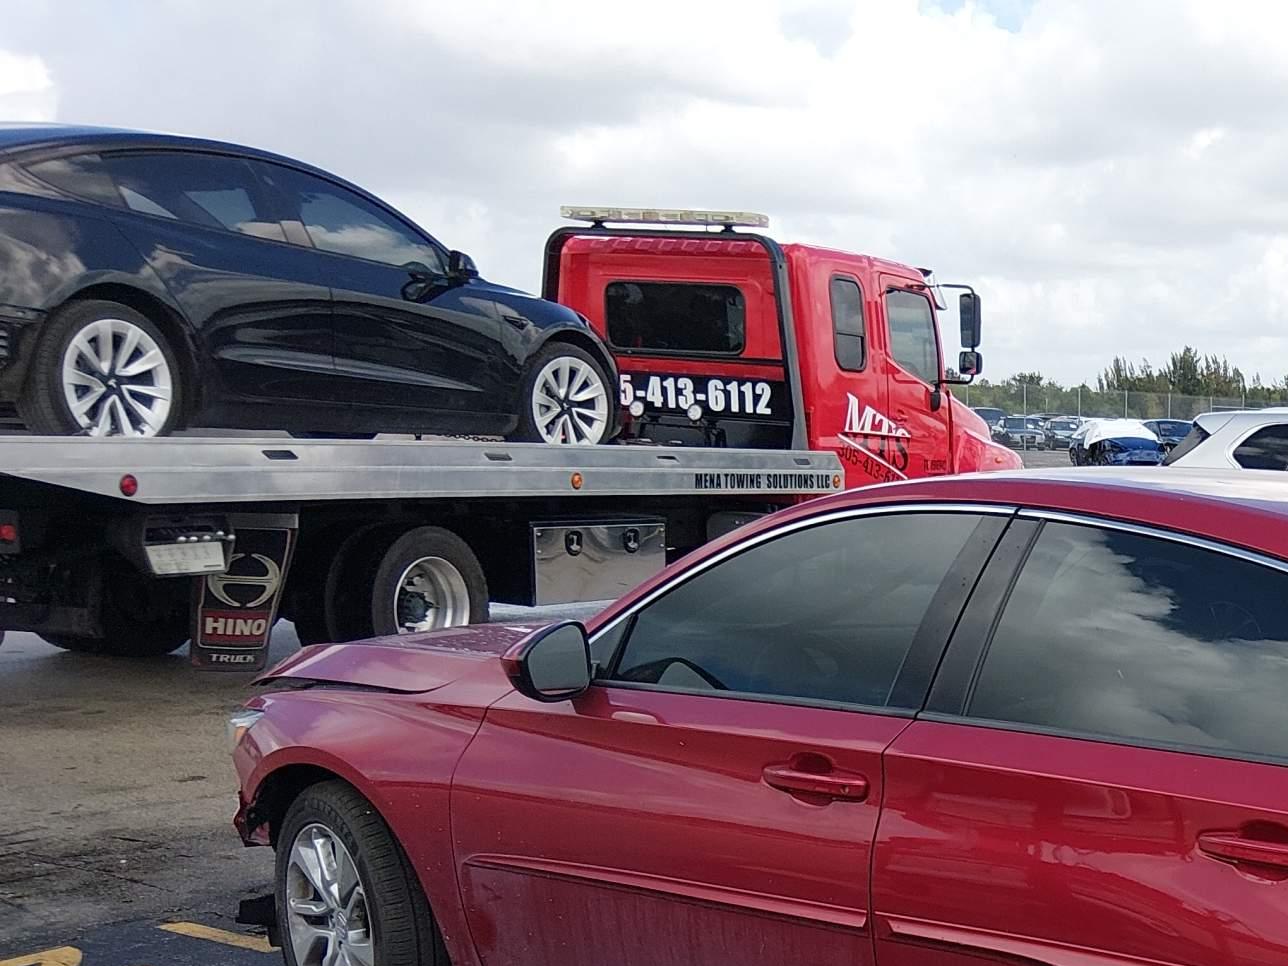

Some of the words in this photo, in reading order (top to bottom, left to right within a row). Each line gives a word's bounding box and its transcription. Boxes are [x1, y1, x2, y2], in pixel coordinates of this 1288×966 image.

[694, 473, 722, 489] MENA
[723, 473, 762, 489] TOWING
[766, 474, 814, 489] SOLUTIONS
[816, 474, 831, 489] LLC
[204, 617, 267, 636] HINO
[207, 653, 256, 663] TRUCK
